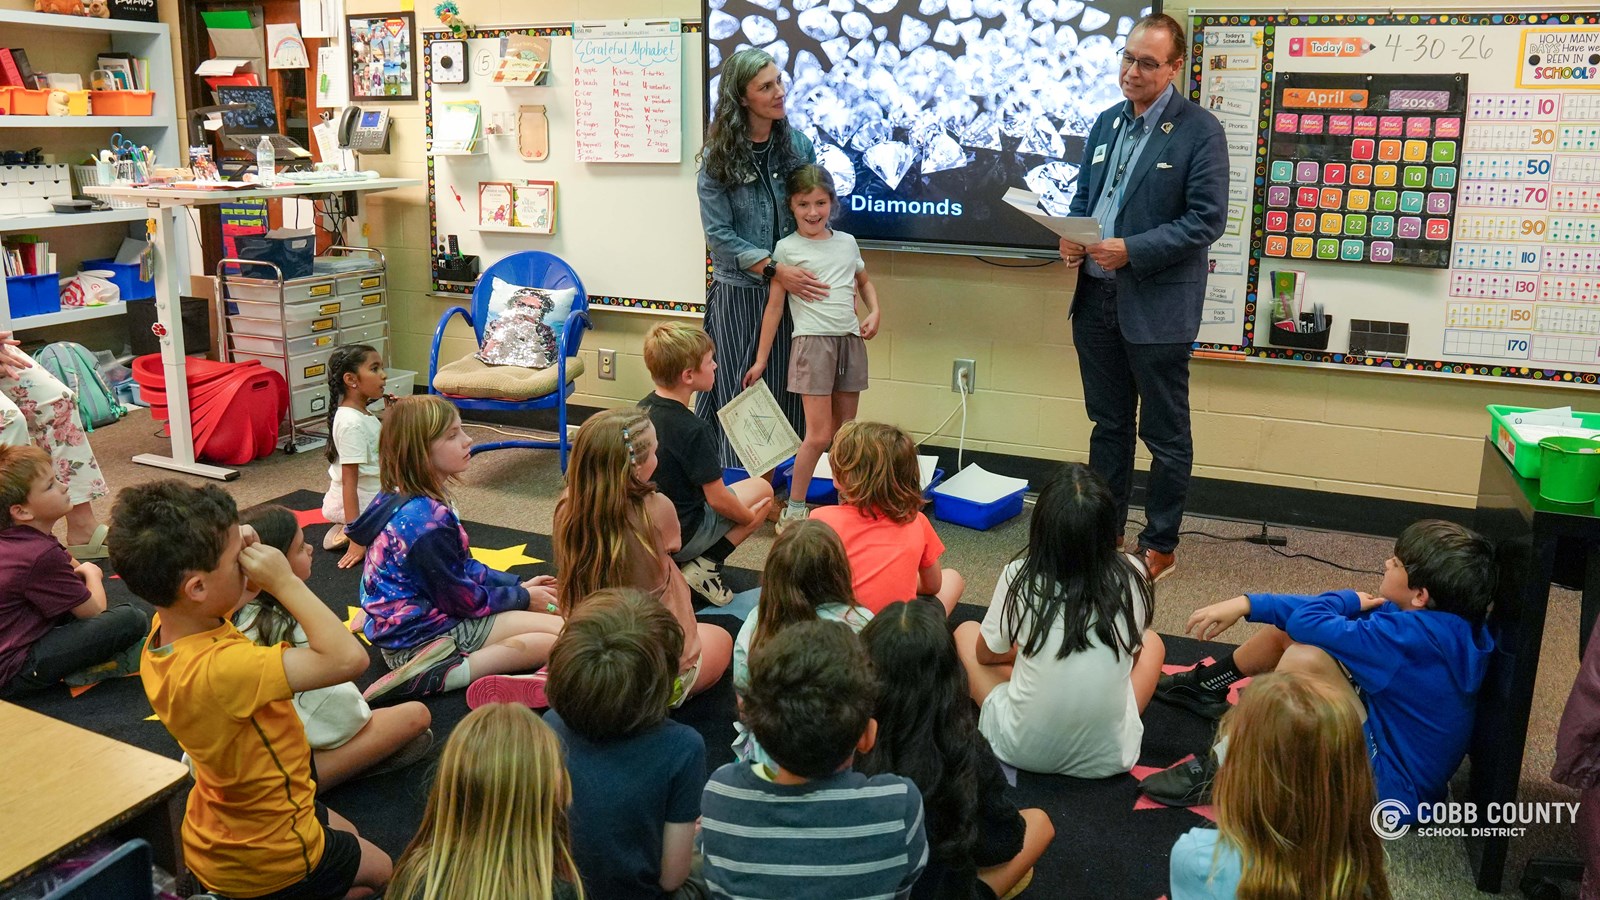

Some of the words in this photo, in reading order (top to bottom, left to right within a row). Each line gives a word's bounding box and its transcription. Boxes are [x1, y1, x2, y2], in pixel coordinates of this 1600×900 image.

[1540, 34, 1567, 44] HOW
[1570, 34, 1599, 44] MANY
[586, 41, 627, 56] Grateful
[630, 40, 676, 60] Alphabet
[1311, 41, 1342, 56] Today
[1346, 44, 1354, 52] is
[1530, 44, 1560, 54] DAYS
[1562, 44, 1584, 52] Have
[478, 55, 490, 71] 15
[1546, 54, 1570, 64] BEEN
[1573, 54, 1584, 64] IN
[1534, 66, 1597, 79] SCHOOL?
[1306, 90, 1344, 105] April
[1401, 98, 1436, 108] 2026
[1538, 99, 1555, 115] 10
[1532, 129, 1555, 145] 30
[1361, 145, 1366, 154] 1
[1387, 146, 1394, 156] 2
[1413, 146, 1420, 156] 3
[1440, 148, 1448, 156] 4
[1280, 166, 1286, 176] 5
[1304, 168, 1310, 176] 6
[1332, 170, 1340, 178] 7
[1357, 170, 1365, 179] 8
[1382, 171, 1390, 180] 9
[1410, 172, 1422, 181] 10
[1439, 173, 1449, 182] 11
[1526, 160, 1550, 175] 50
[1274, 192, 1284, 201] 12
[1303, 192, 1314, 202] 13
[1326, 194, 1336, 203] 14
[1354, 195, 1364, 204] 15
[1380, 196, 1391, 206] 16
[1406, 197, 1418, 206] 17
[1433, 198, 1445, 208] 18
[1525, 188, 1548, 203] 70
[852, 195, 962, 216] Diamonds
[1271, 216, 1282, 225] 19
[1298, 218, 1312, 227] 20
[1326, 219, 1337, 228] 21
[1349, 220, 1362, 230] 22
[1376, 222, 1389, 231] 23
[1403, 223, 1416, 232] 24
[1431, 224, 1444, 234] 25
[1521, 220, 1546, 235] 90
[1270, 242, 1283, 250] 26
[1296, 244, 1310, 252] 27
[1322, 245, 1335, 254] 28
[1346, 246, 1360, 255] 29
[1375, 248, 1389, 256] 30
[1521, 252, 1536, 263] 110
[1212, 286, 1226, 294] Social
[1516, 281, 1535, 293] 130
[1510, 310, 1531, 321] 150
[1508, 340, 1527, 351] 170
